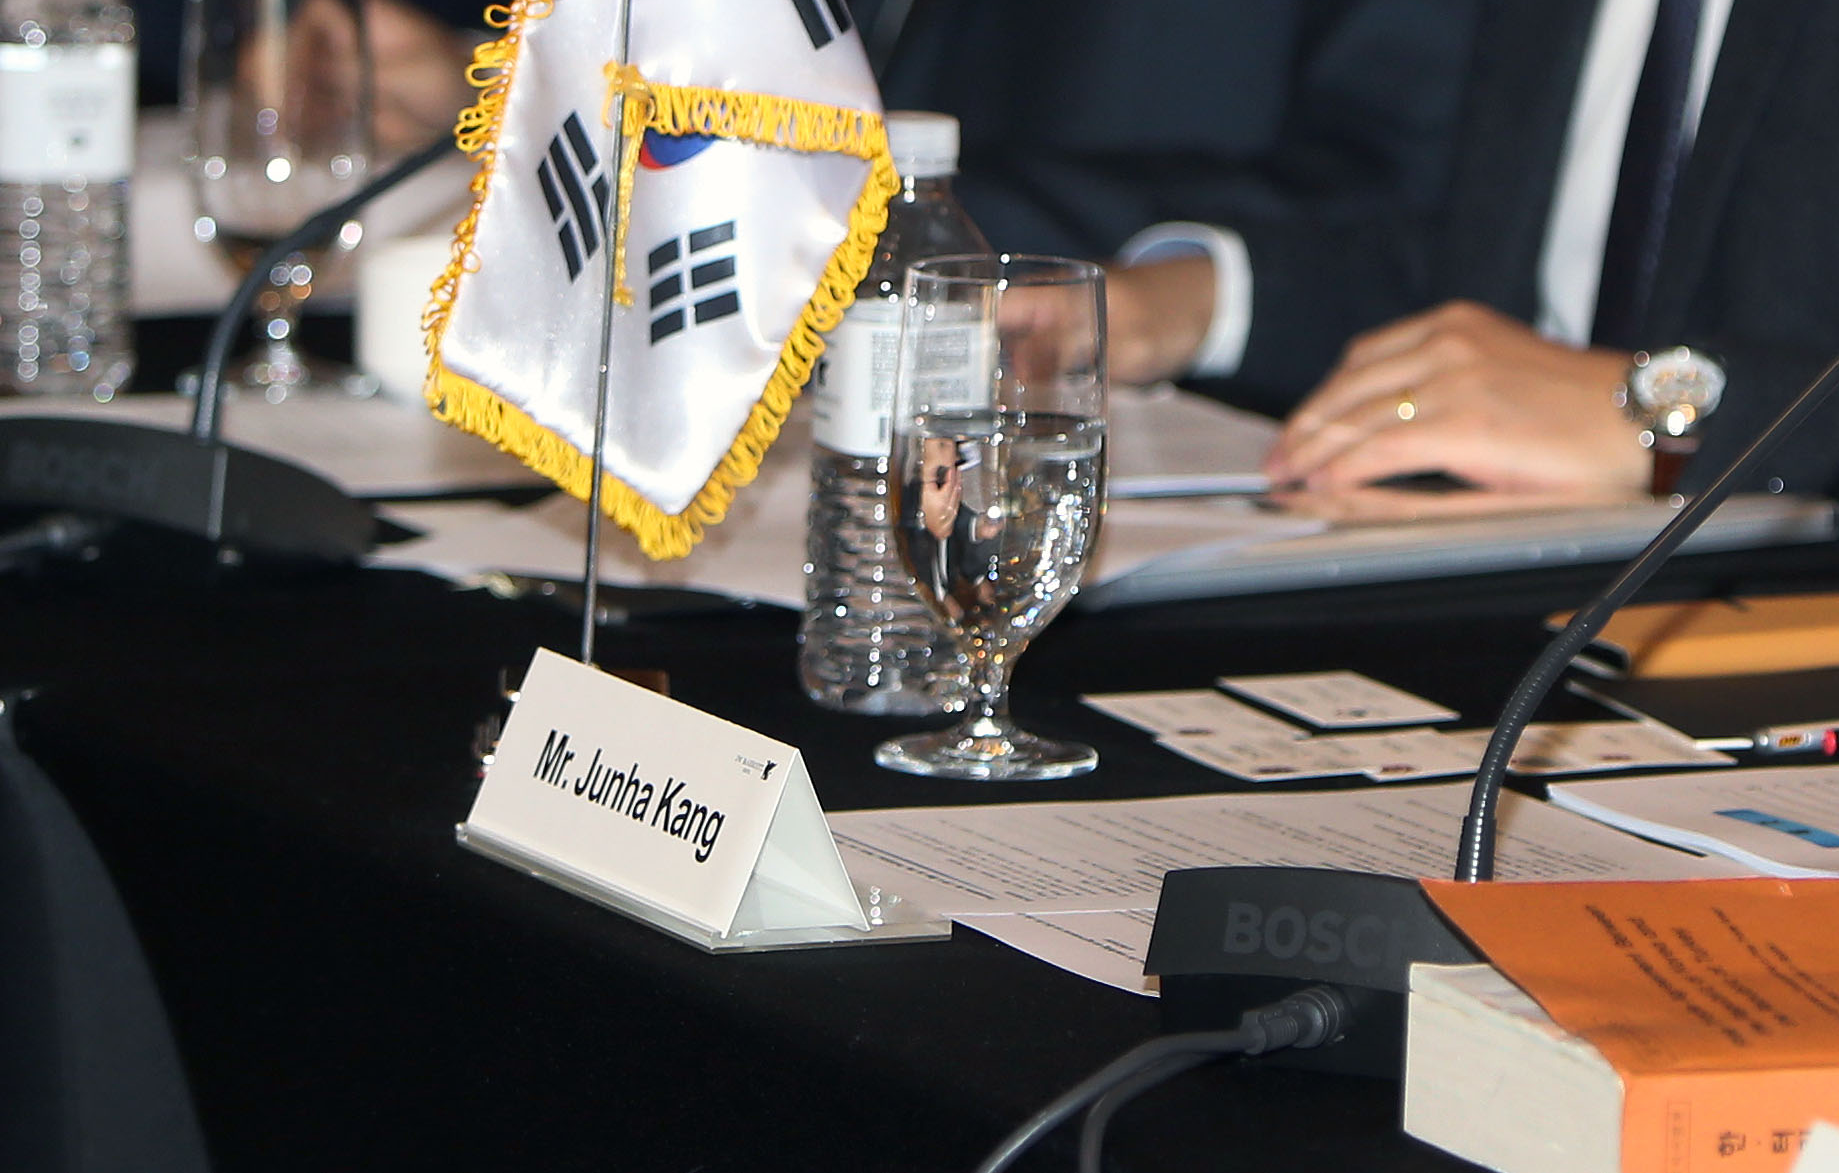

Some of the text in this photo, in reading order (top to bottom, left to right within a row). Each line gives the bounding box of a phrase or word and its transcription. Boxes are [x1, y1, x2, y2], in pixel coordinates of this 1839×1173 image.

[533, 729, 726, 864] Mr. Junha Kang
